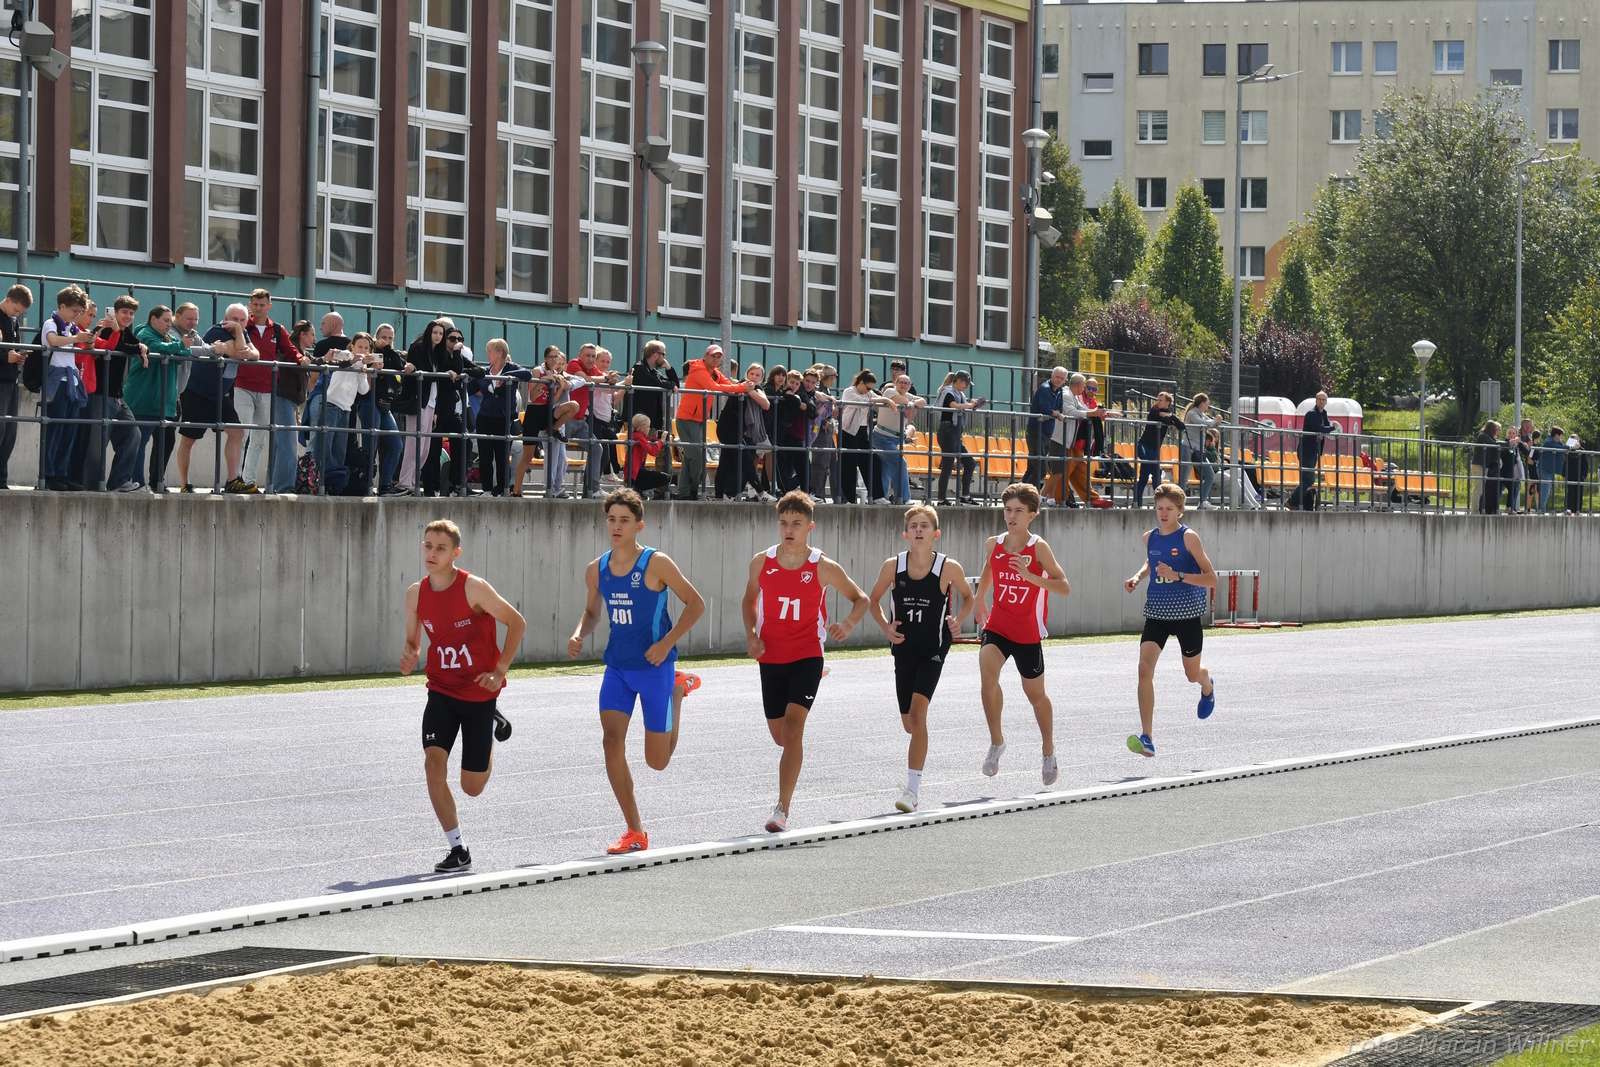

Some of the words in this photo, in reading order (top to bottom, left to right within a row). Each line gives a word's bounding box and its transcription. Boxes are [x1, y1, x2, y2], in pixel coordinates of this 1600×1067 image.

[998, 583, 1030, 605] 757
[612, 608, 633, 625] 401
[777, 596, 801, 621] 71
[906, 609, 923, 623] 11
[436, 643, 474, 670] 121
